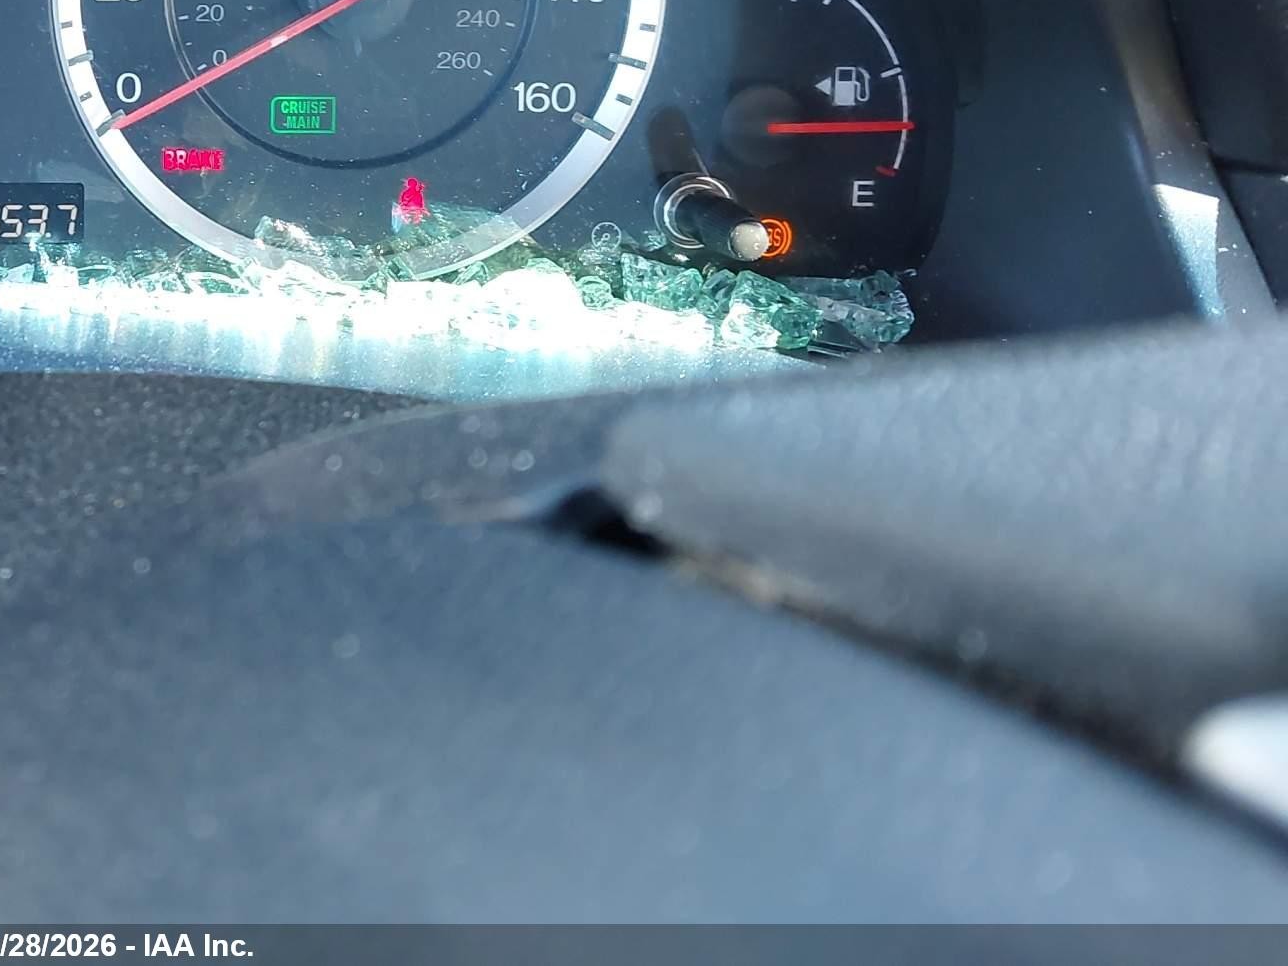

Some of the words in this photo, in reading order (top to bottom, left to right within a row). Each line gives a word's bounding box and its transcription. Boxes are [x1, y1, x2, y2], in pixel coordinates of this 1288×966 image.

[196, 5, 224, 21] 20
[456, 10, 500, 27] 240
[437, 52, 480, 69] 260
[117, 73, 141, 102] 0
[514, 82, 575, 112] 160
[281, 101, 328, 114] CRUISE
[287, 116, 320, 129] MAIN
[163, 149, 224, 170] BRAKE
[852, 181, 874, 206] E
